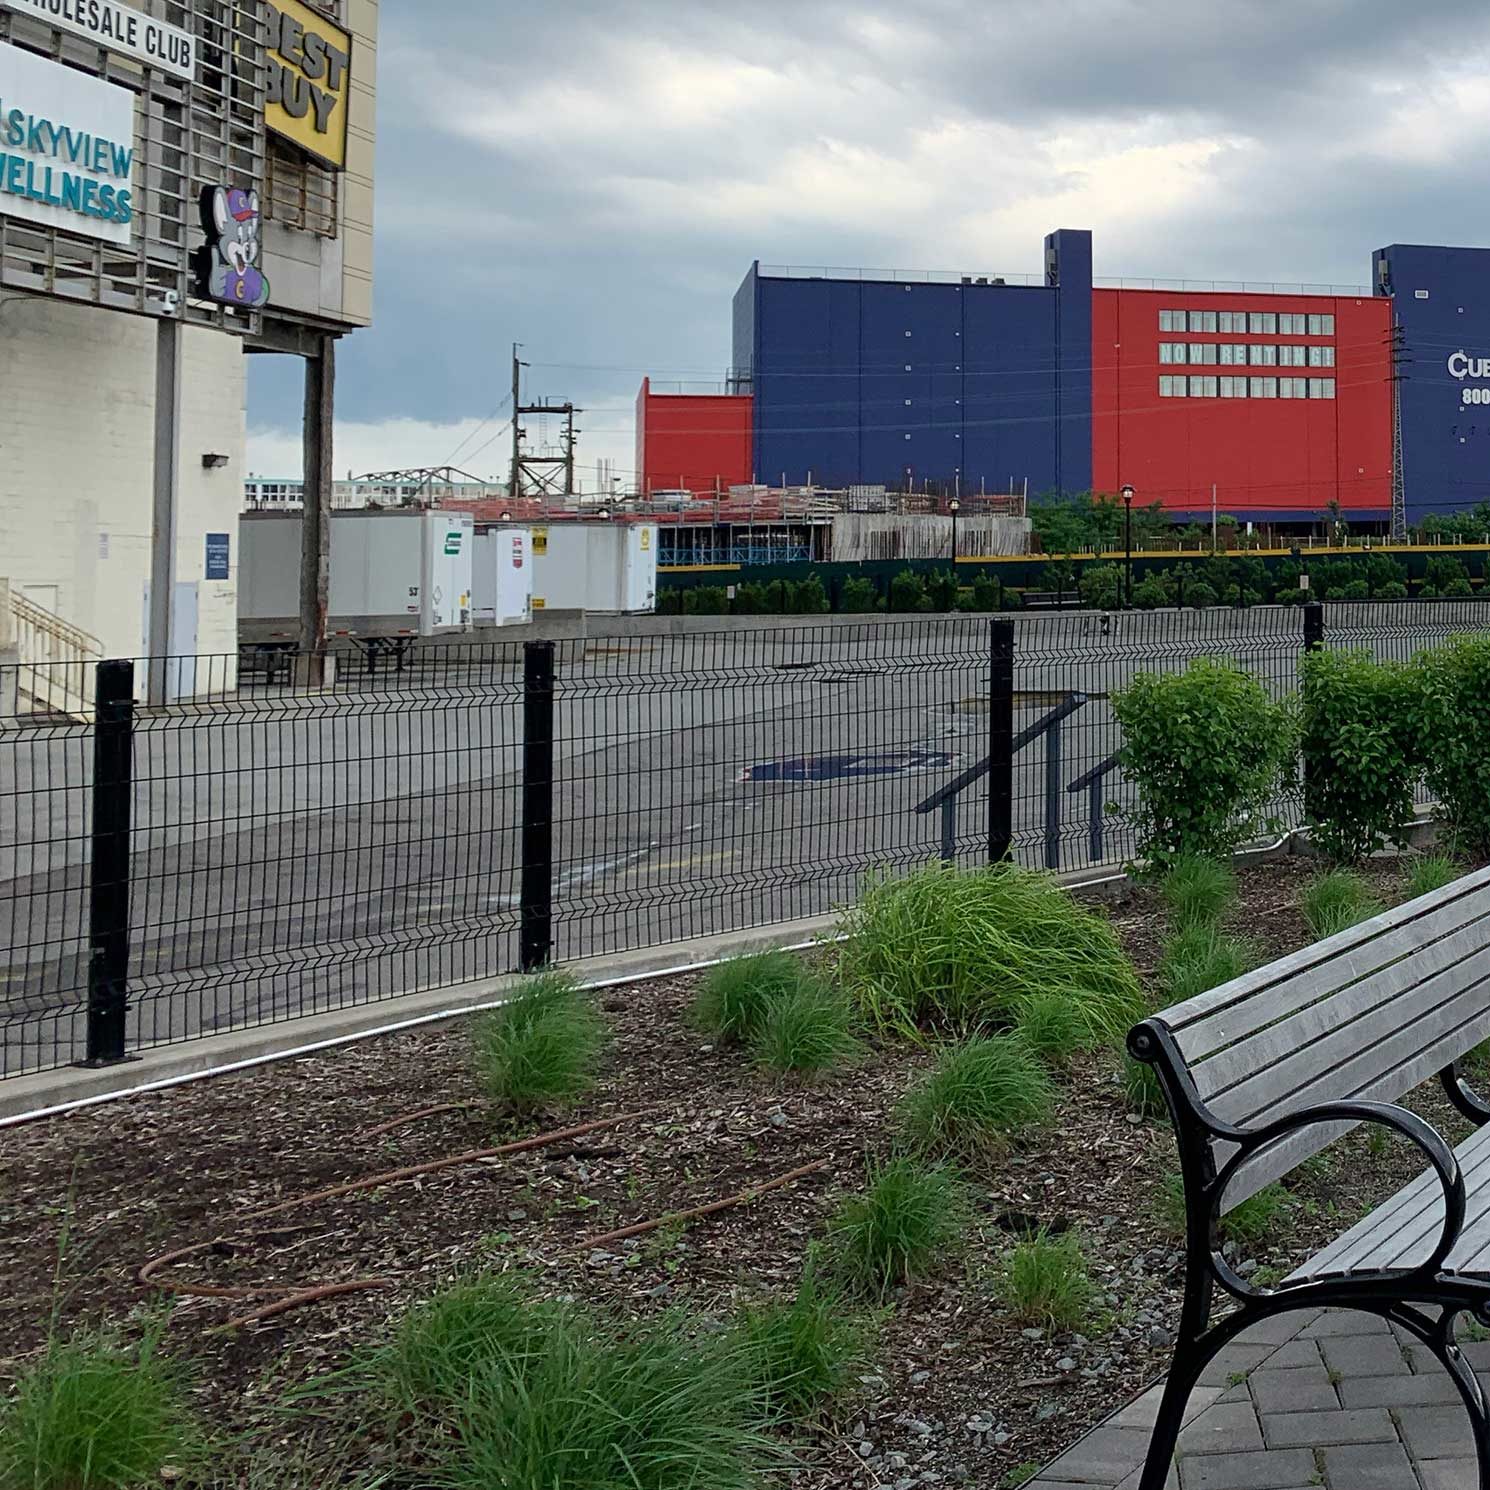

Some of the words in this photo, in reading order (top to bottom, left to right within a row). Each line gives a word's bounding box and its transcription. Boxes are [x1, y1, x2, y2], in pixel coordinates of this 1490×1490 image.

[24, 0, 137, 47] OLESALE
[145, 25, 191, 68] CLUB
[265, 2, 348, 92] BEST
[265, 54, 338, 134] BUY
[7, 109, 132, 179] SKYVIEW
